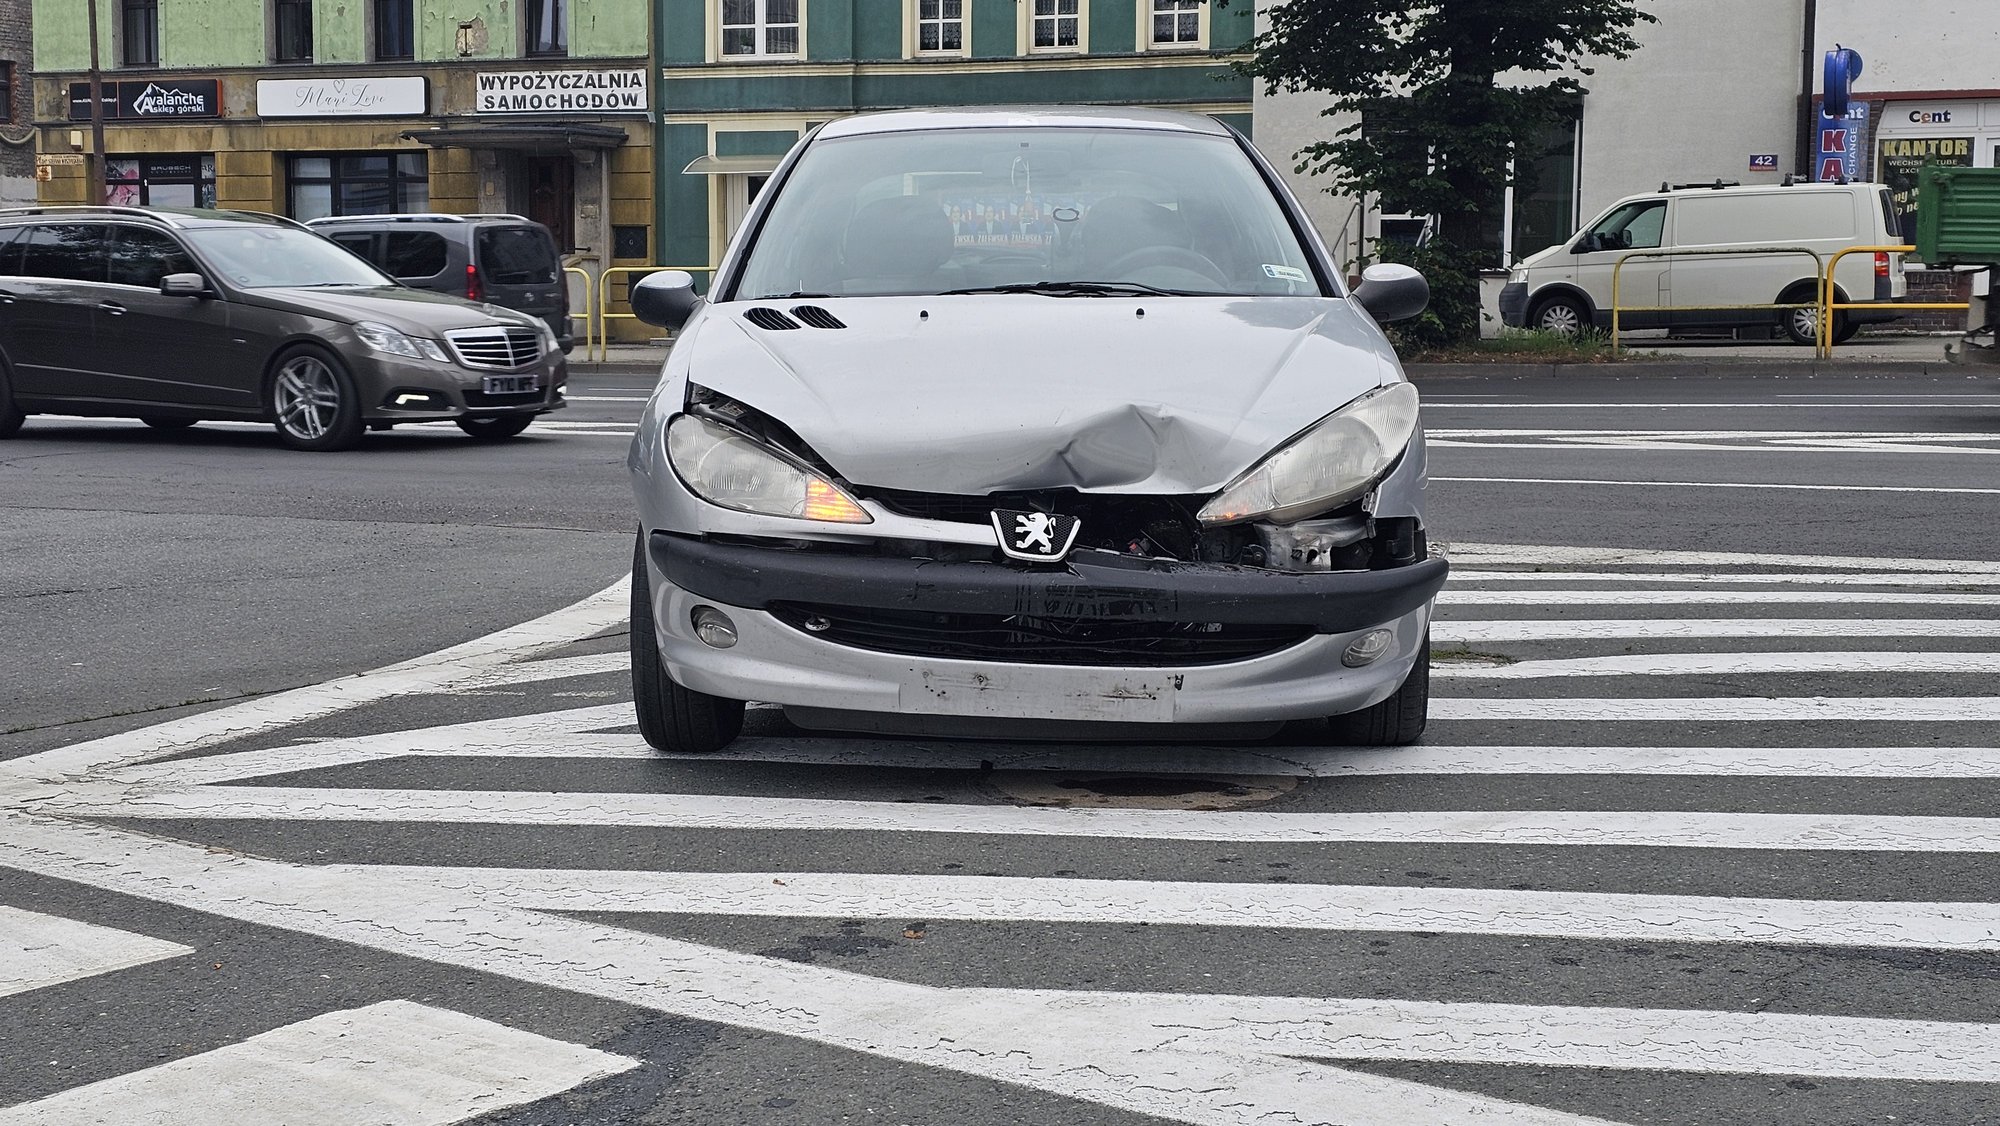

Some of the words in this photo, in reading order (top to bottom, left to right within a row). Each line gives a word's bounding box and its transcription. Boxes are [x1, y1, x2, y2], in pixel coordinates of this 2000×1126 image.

[479, 71, 642, 91] WYPOŻYCZALNIA
[140, 92, 204, 113] Avalanche
[153, 105, 174, 114] sklep
[177, 104, 204, 114] górski
[484, 91, 638, 110] SAMOCHODÓW
[1909, 110, 1951, 123] Cent
[1883, 139, 1968, 157] KANTOR
[1755, 156, 1773, 165] 42
